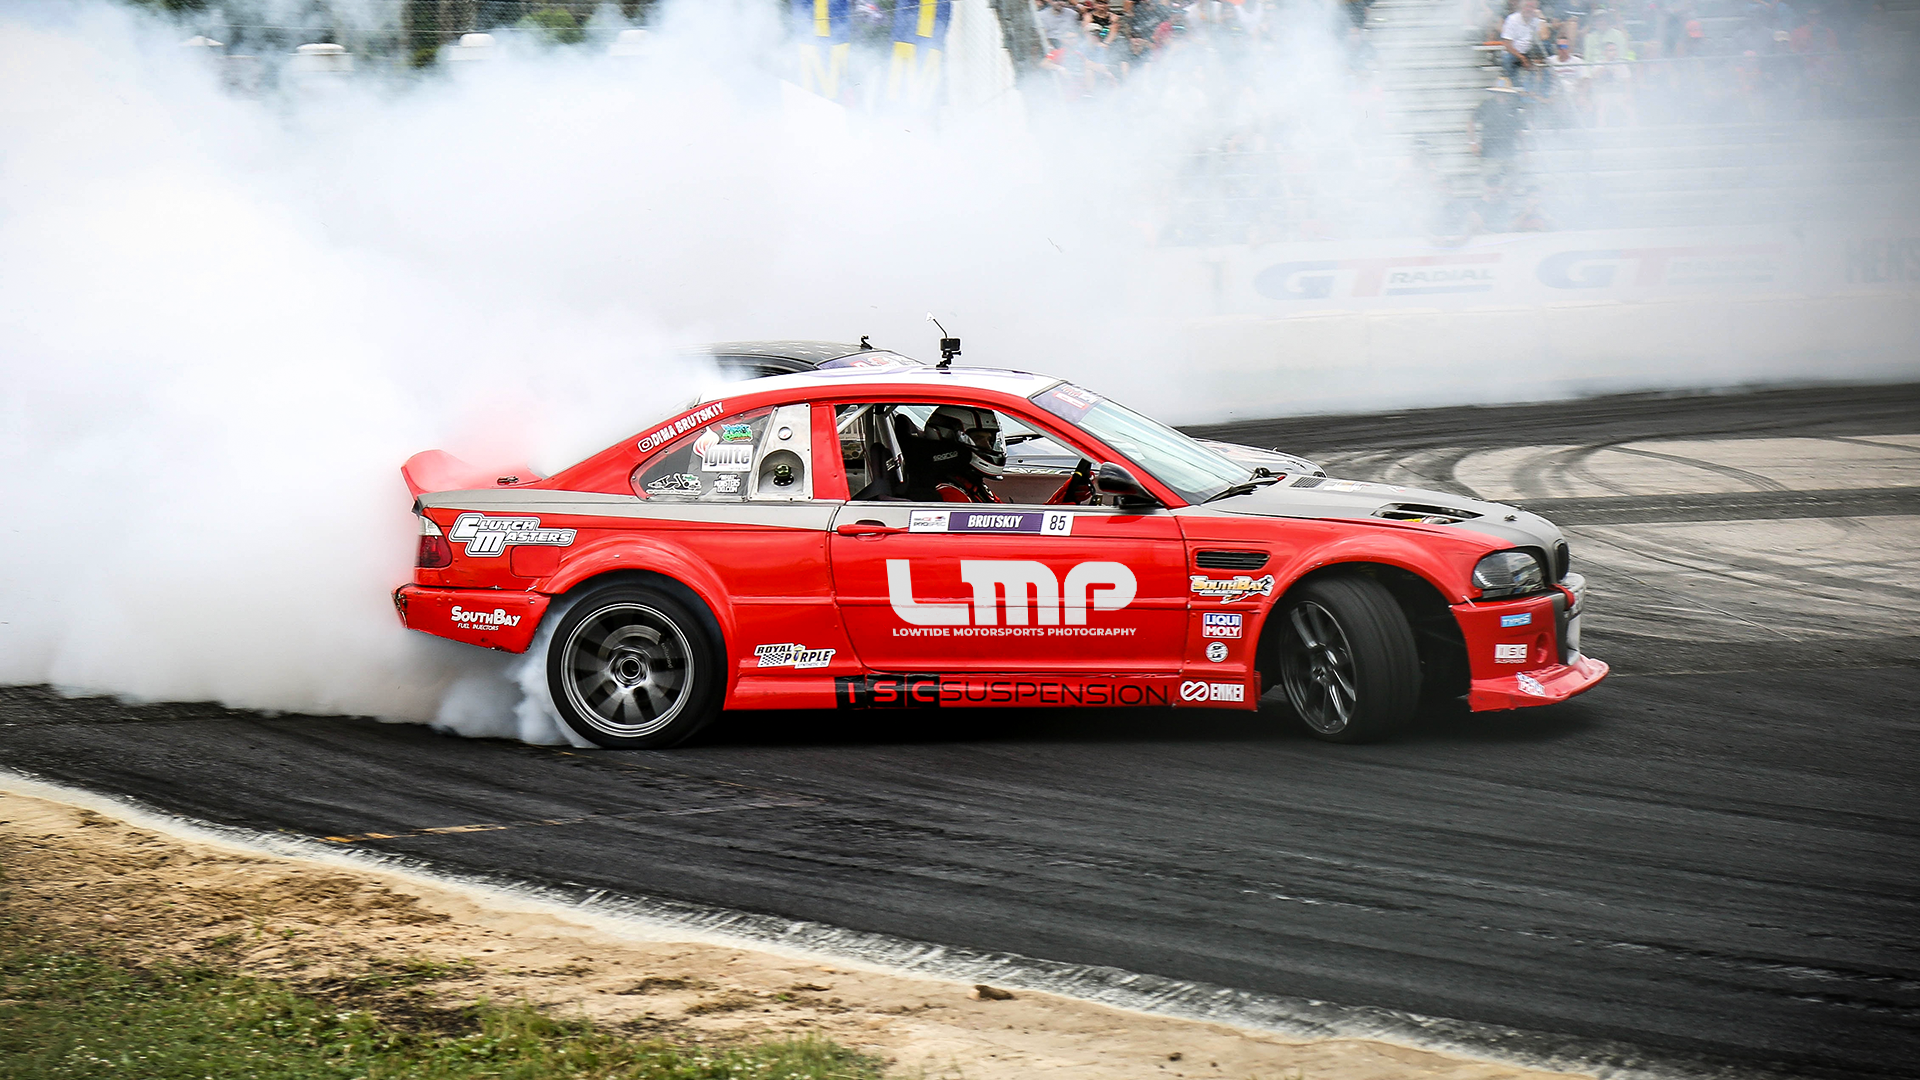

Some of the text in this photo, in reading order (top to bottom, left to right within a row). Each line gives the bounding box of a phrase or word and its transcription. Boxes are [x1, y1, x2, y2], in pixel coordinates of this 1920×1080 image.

[1254, 253, 1502, 300] GT
[1389, 268, 1494, 284] RADIAL
[650, 424, 678, 447] DIMA
[674, 402, 724, 434] BRUTSKIY
[704, 446, 750, 467] ignite
[453, 517, 537, 538] CLUTCH
[967, 514, 1067, 531] BRUTSKIY 85
[470, 531, 572, 552] MASTERS
[886, 559, 1138, 626] LMP
[457, 622, 499, 631] FUEL INJECTORS
[1206, 615, 1240, 626] LIQUI
[892, 627, 1137, 637] LOWTIDE MOTORSPORTS PHOTOGRAPHY
[1205, 626, 1240, 637] MOLY
[756, 644, 792, 654] ROYAL
[783, 650, 831, 664] PURPLE
[848, 681, 1169, 704] ISC SUSPENSION
[1210, 683, 1245, 702] ENKEI
